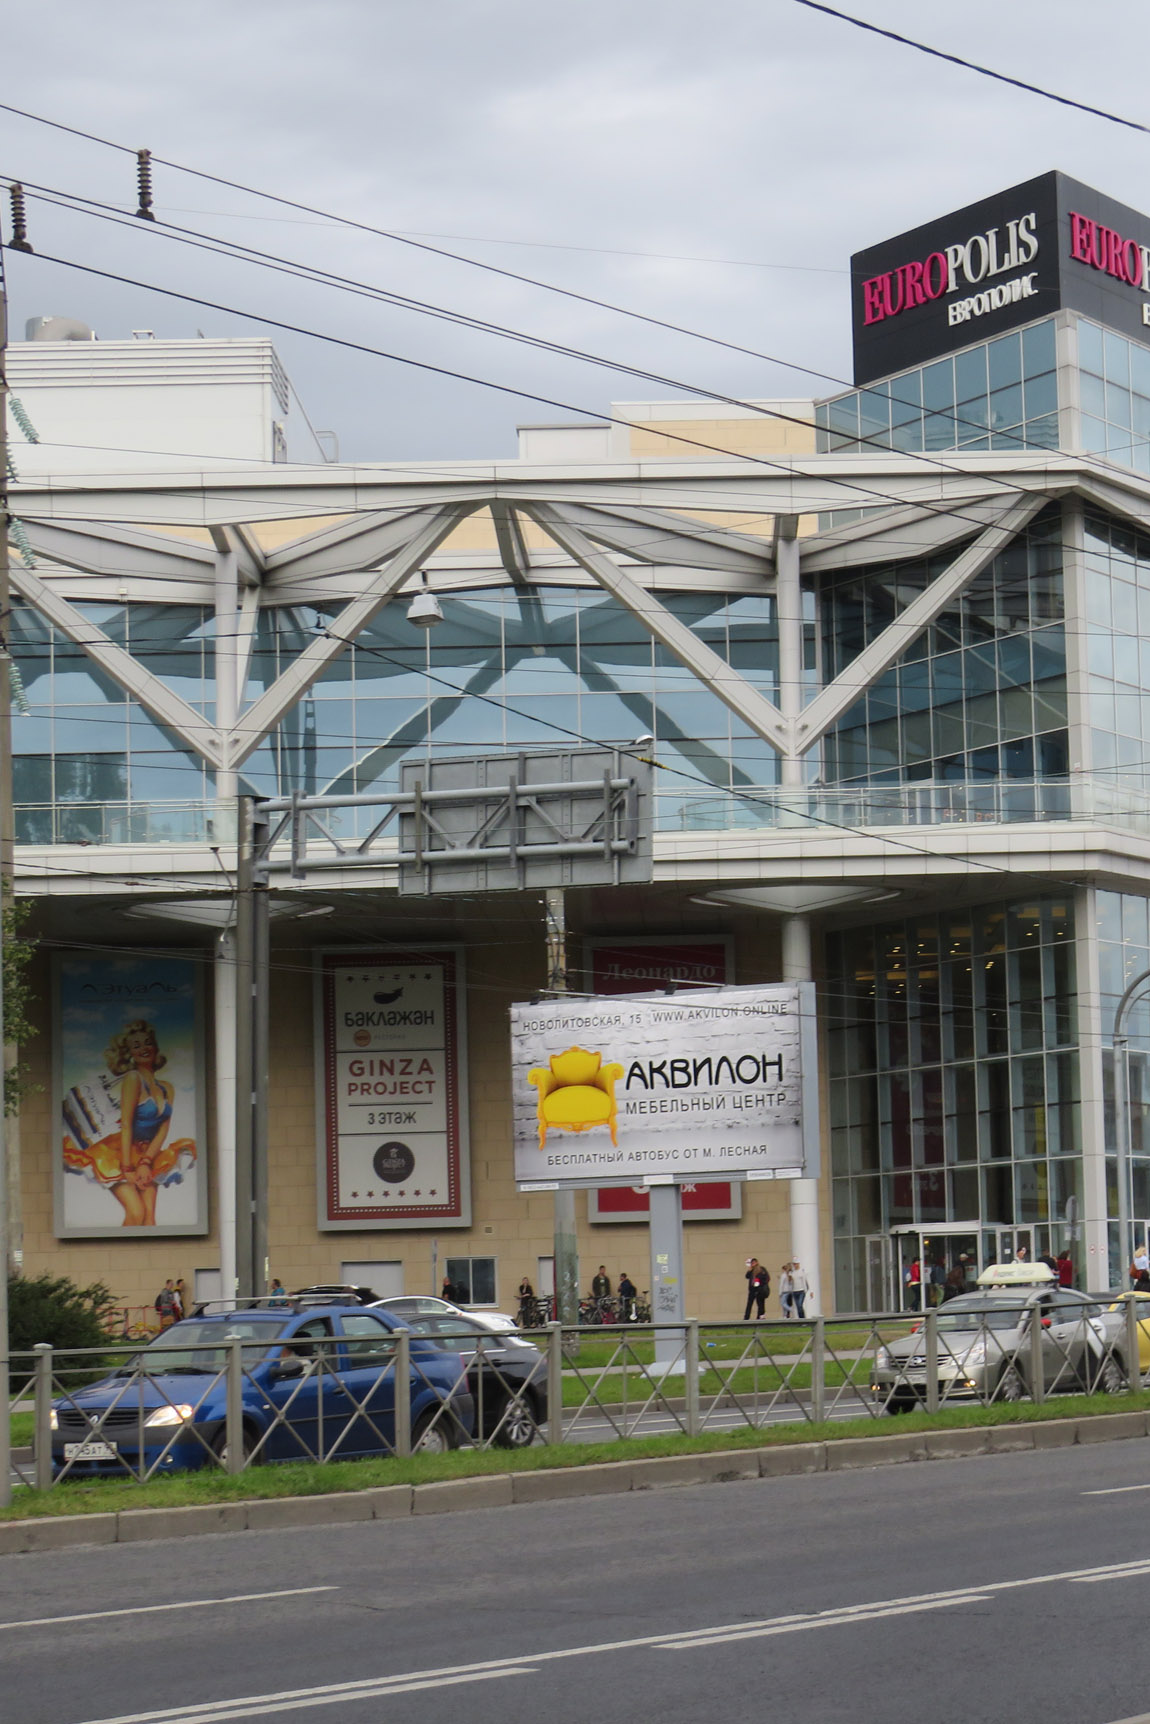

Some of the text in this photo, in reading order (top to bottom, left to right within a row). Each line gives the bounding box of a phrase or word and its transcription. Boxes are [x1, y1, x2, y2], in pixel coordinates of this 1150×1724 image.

[861, 212, 1038, 326] EUROPOLIS
[948, 272, 1038, 326] ЕВРОПОЛИС
[523, 1003, 787, 1031] НОВОЛИТОВСКАЯ, 15 WWW.AKVILON.ONLINE
[349, 1058, 434, 1077] GINZA
[626, 1053, 783, 1090] АКВИЛОН
[347, 1080, 435, 1096] PROJECT
[626, 1092, 787, 1115] МЕБЕЛЬНЫЙ ЦЕНТР
[368, 1112, 375, 1125] 3
[547, 1151, 624, 1166] БЕСПЛАТНЫЙ
[627, 1150, 679, 1162] АВТОБУС
[684, 1149, 698, 1159] ОТ
[719, 1145, 767, 1157] ЛЕСНАЯ
